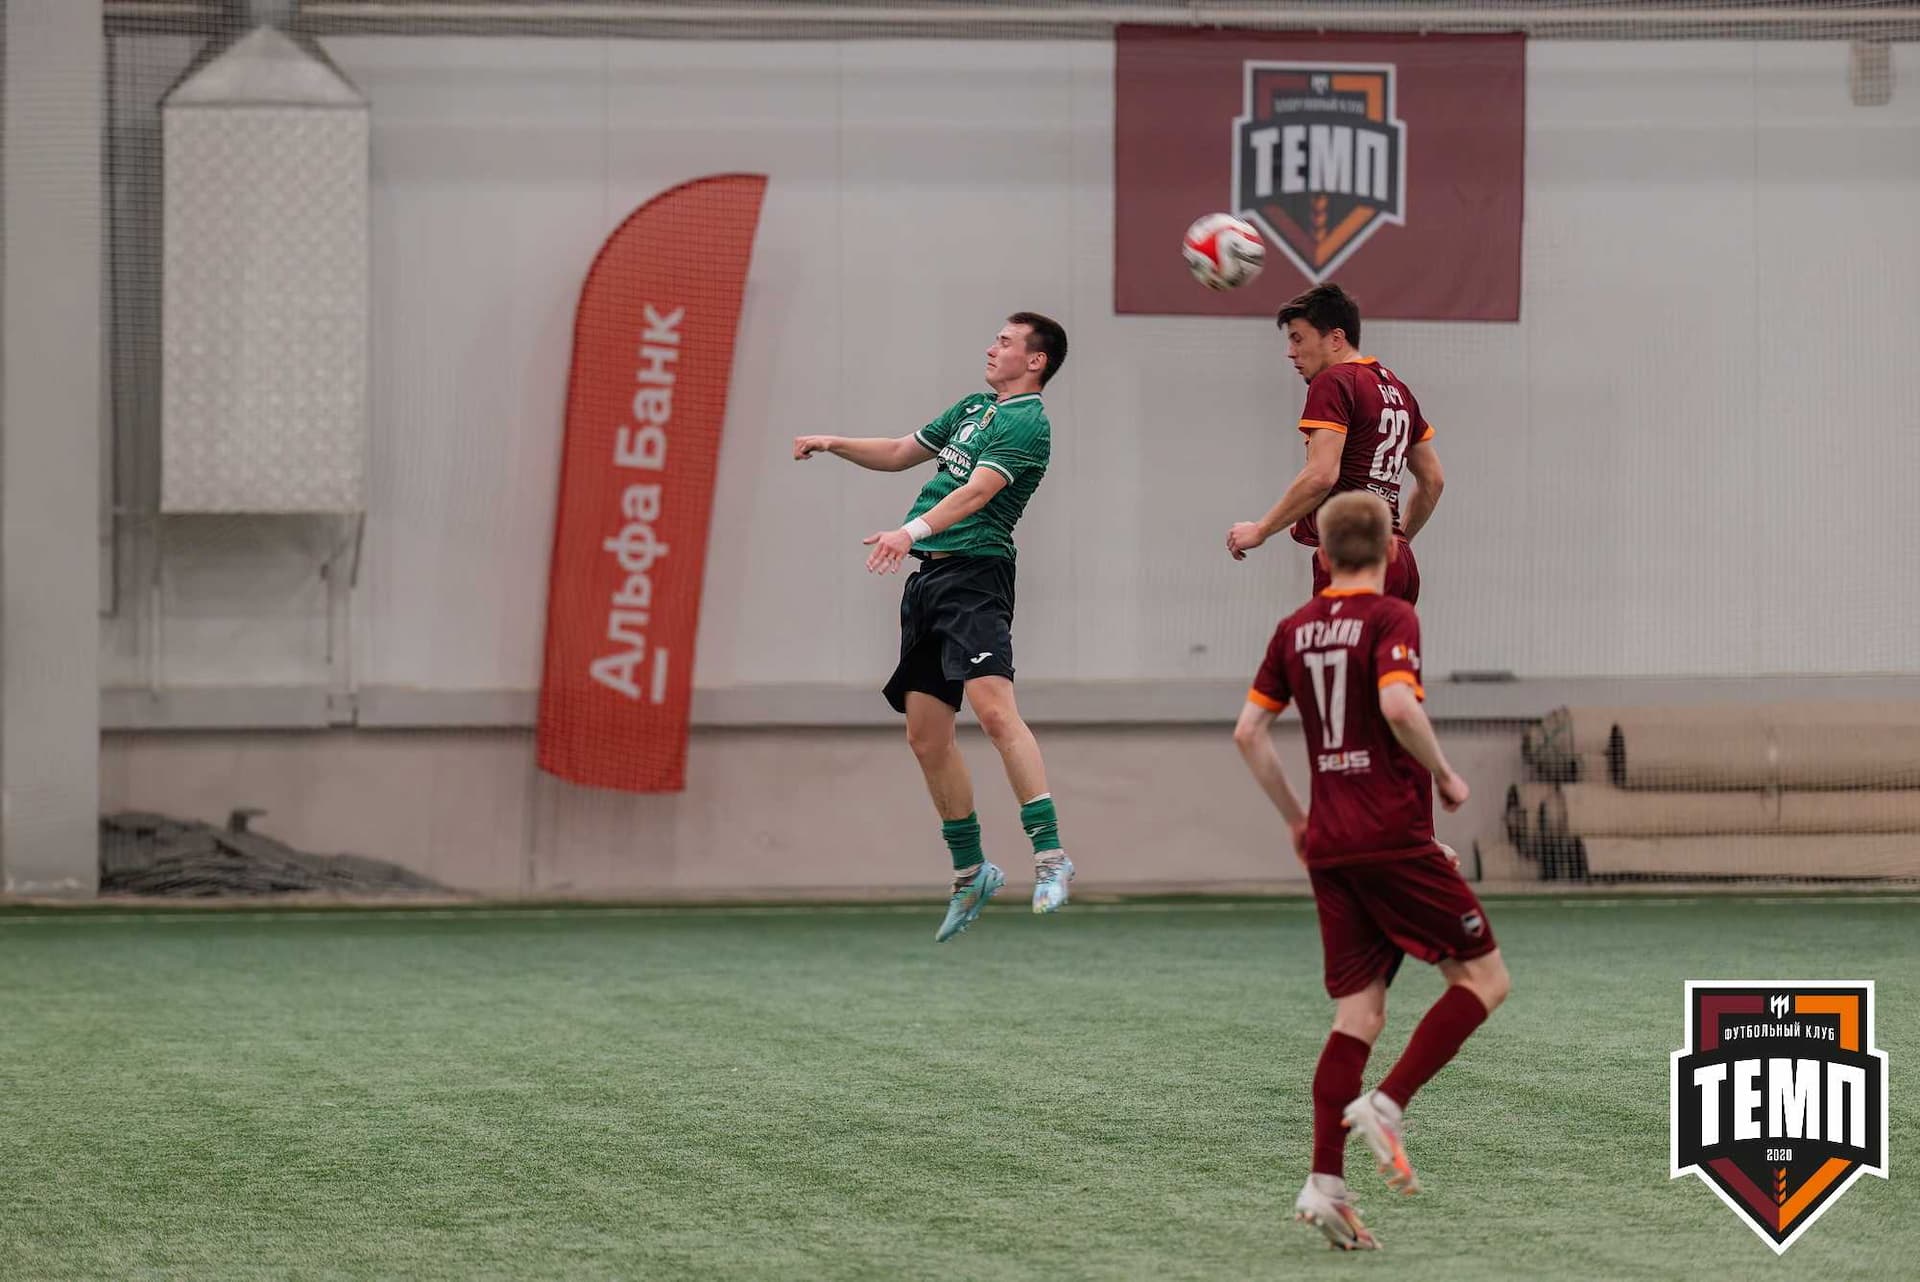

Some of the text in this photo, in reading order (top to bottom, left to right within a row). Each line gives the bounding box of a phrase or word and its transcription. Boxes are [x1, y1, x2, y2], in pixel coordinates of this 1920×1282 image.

[1250, 124, 1389, 201] ТЕМП
[1369, 407, 1409, 486] 22
[590, 304, 685, 699] Альфа Банк
[1303, 649, 1348, 749] 17
